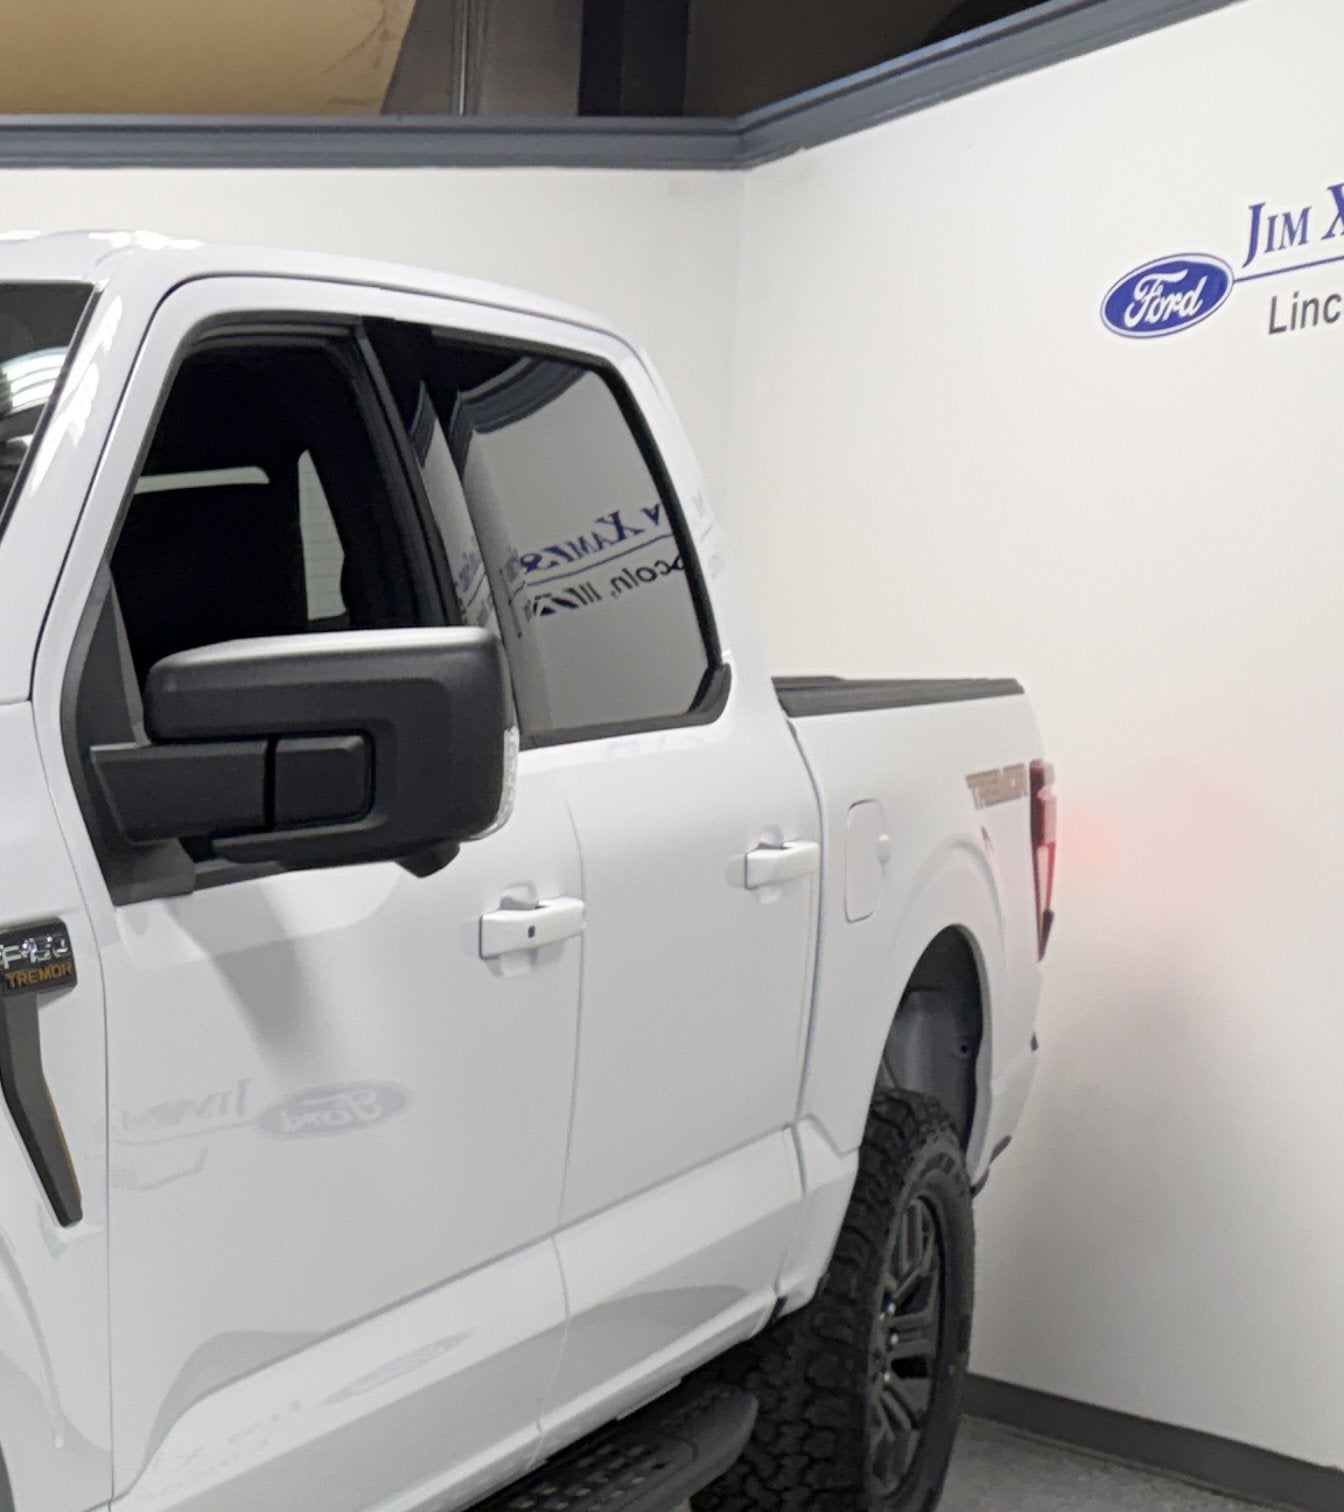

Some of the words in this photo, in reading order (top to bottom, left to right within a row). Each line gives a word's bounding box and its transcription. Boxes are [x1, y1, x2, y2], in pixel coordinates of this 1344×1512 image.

[1242, 202, 1312, 268] JIM
[1124, 269, 1208, 327] Ford
[1269, 290, 1342, 334] Linc
[5, 962, 72, 988] TREMOR
